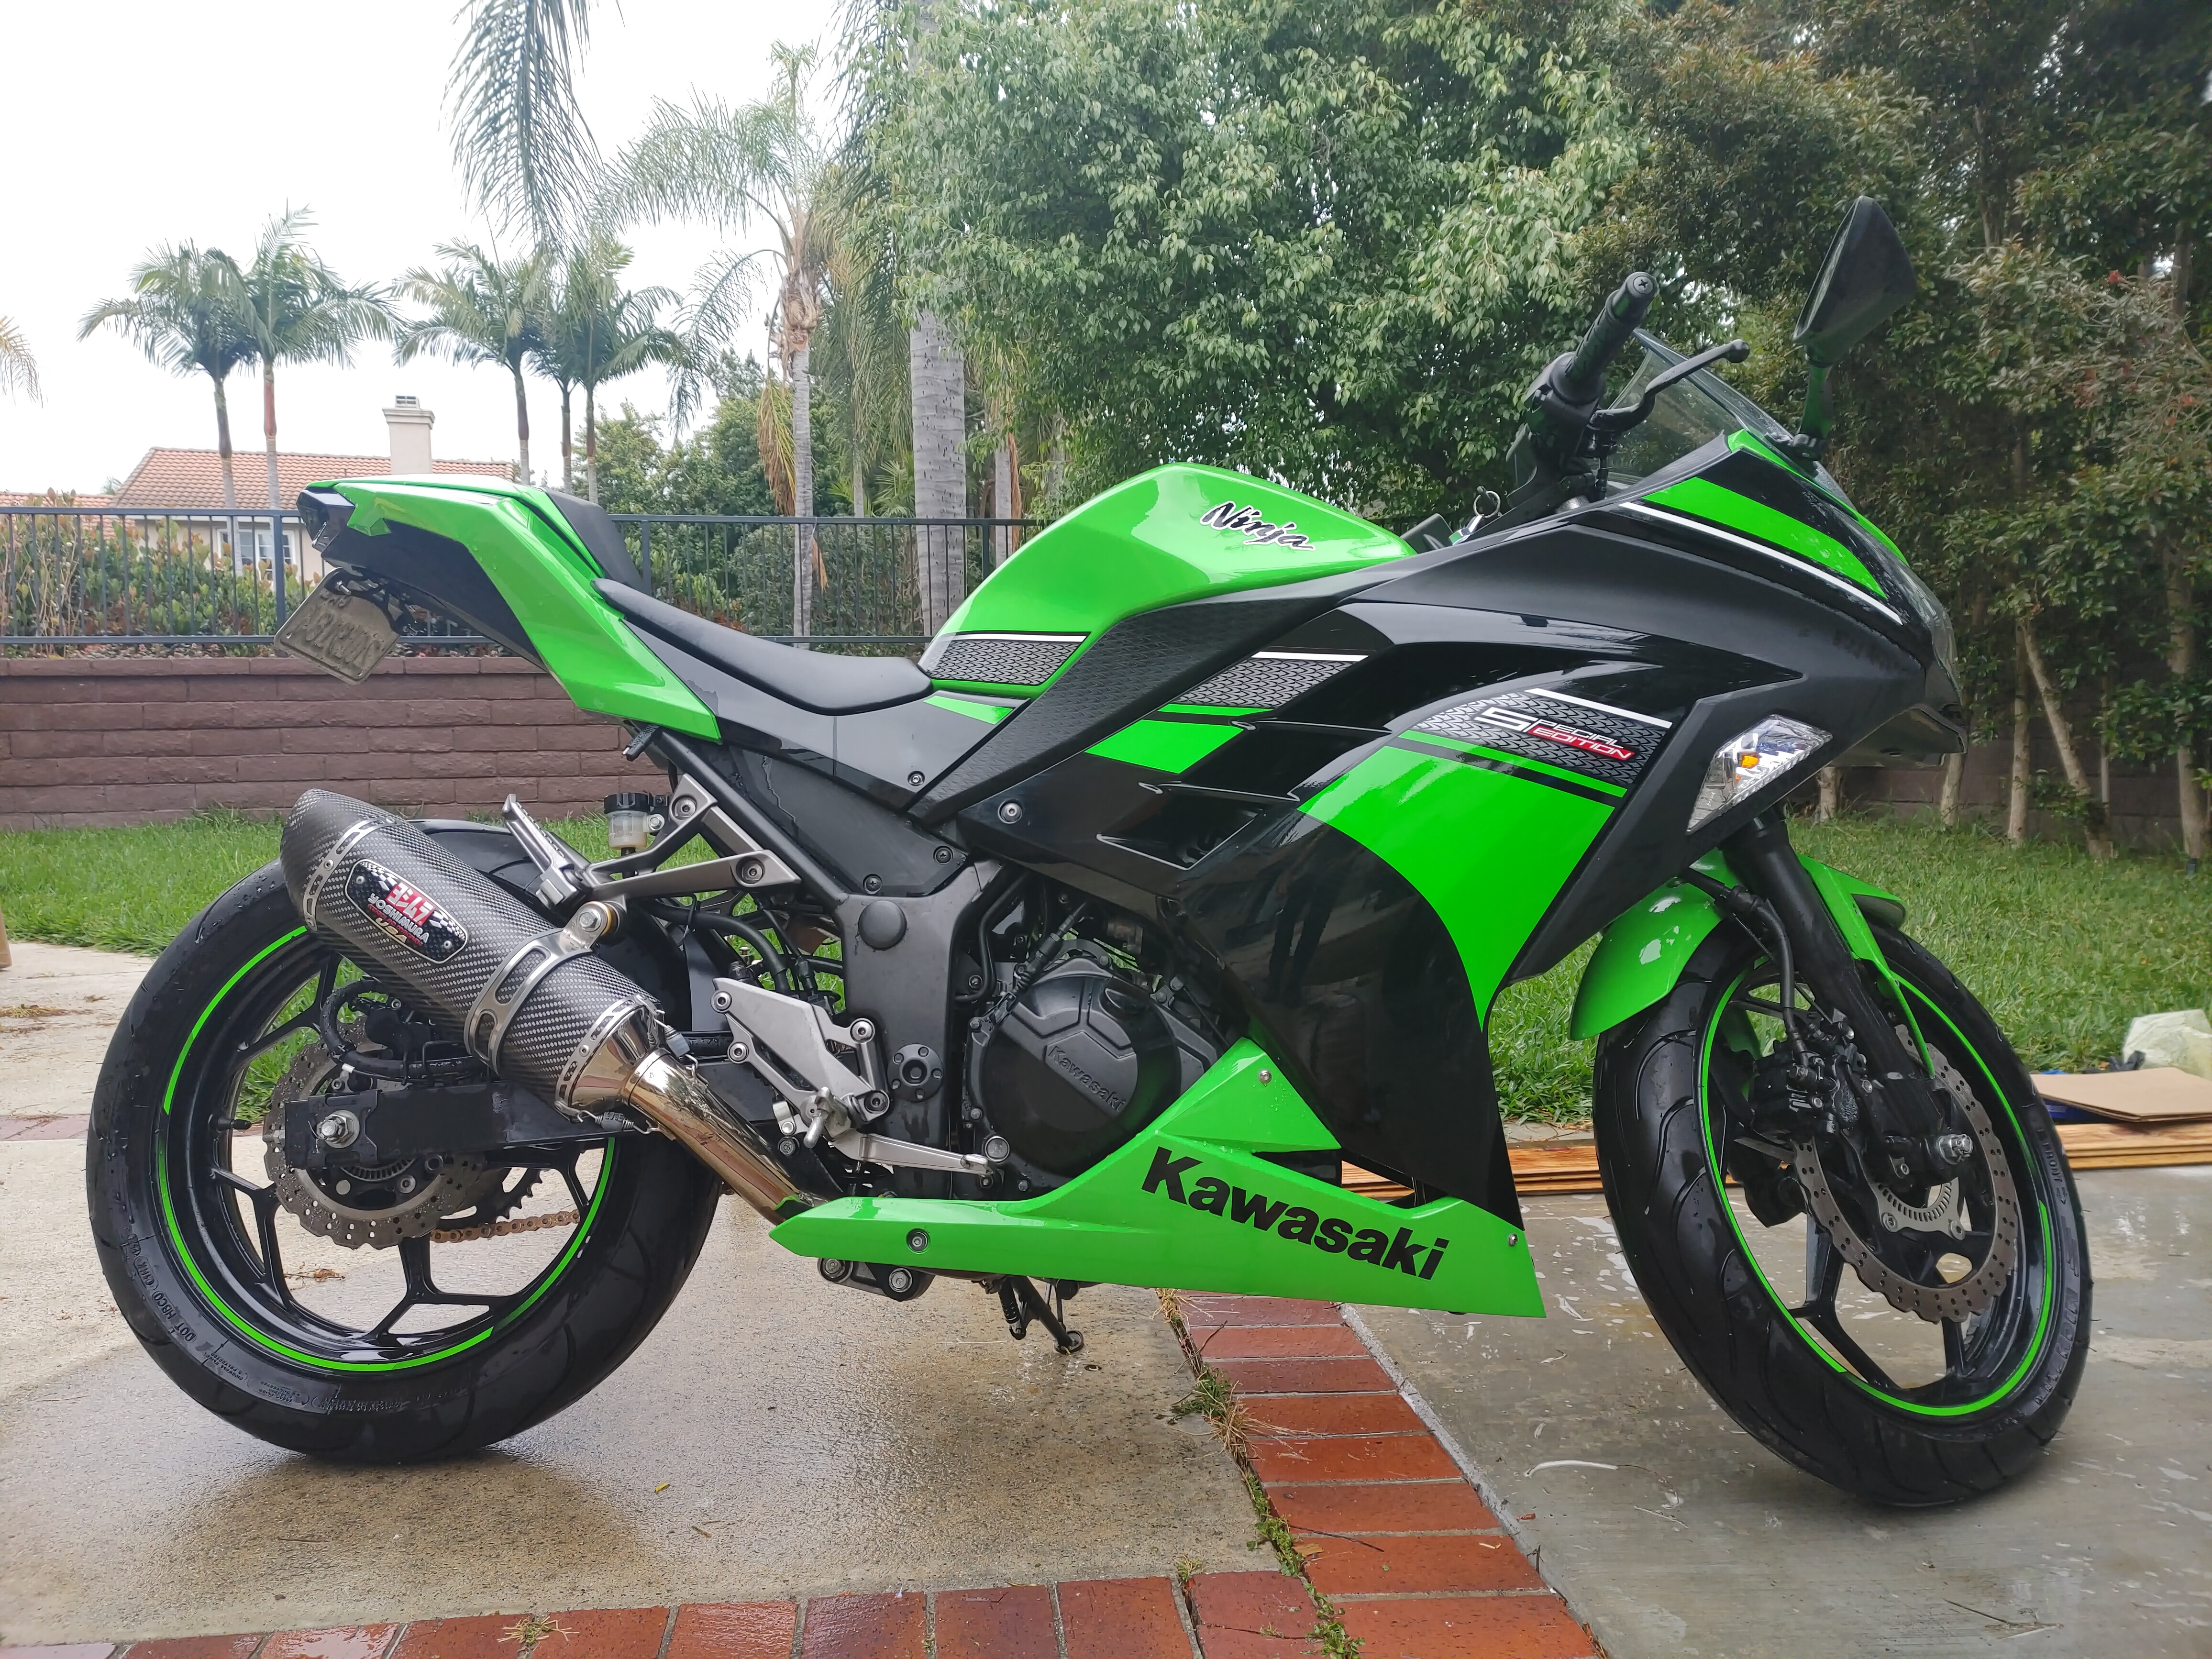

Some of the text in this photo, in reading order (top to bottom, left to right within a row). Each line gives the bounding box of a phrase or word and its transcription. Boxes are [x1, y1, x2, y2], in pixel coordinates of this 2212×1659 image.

[1200, 501, 1316, 551] Ninja
[1474, 707, 1625, 749] SPECIAL
[1532, 727, 1632, 759] EDITION
[368, 893, 430, 943] YOSHIMURA
[375, 917, 408, 943] USA
[1048, 1046, 1126, 1112] Kawasaki
[1141, 1146, 1450, 1280] Kawasaki
